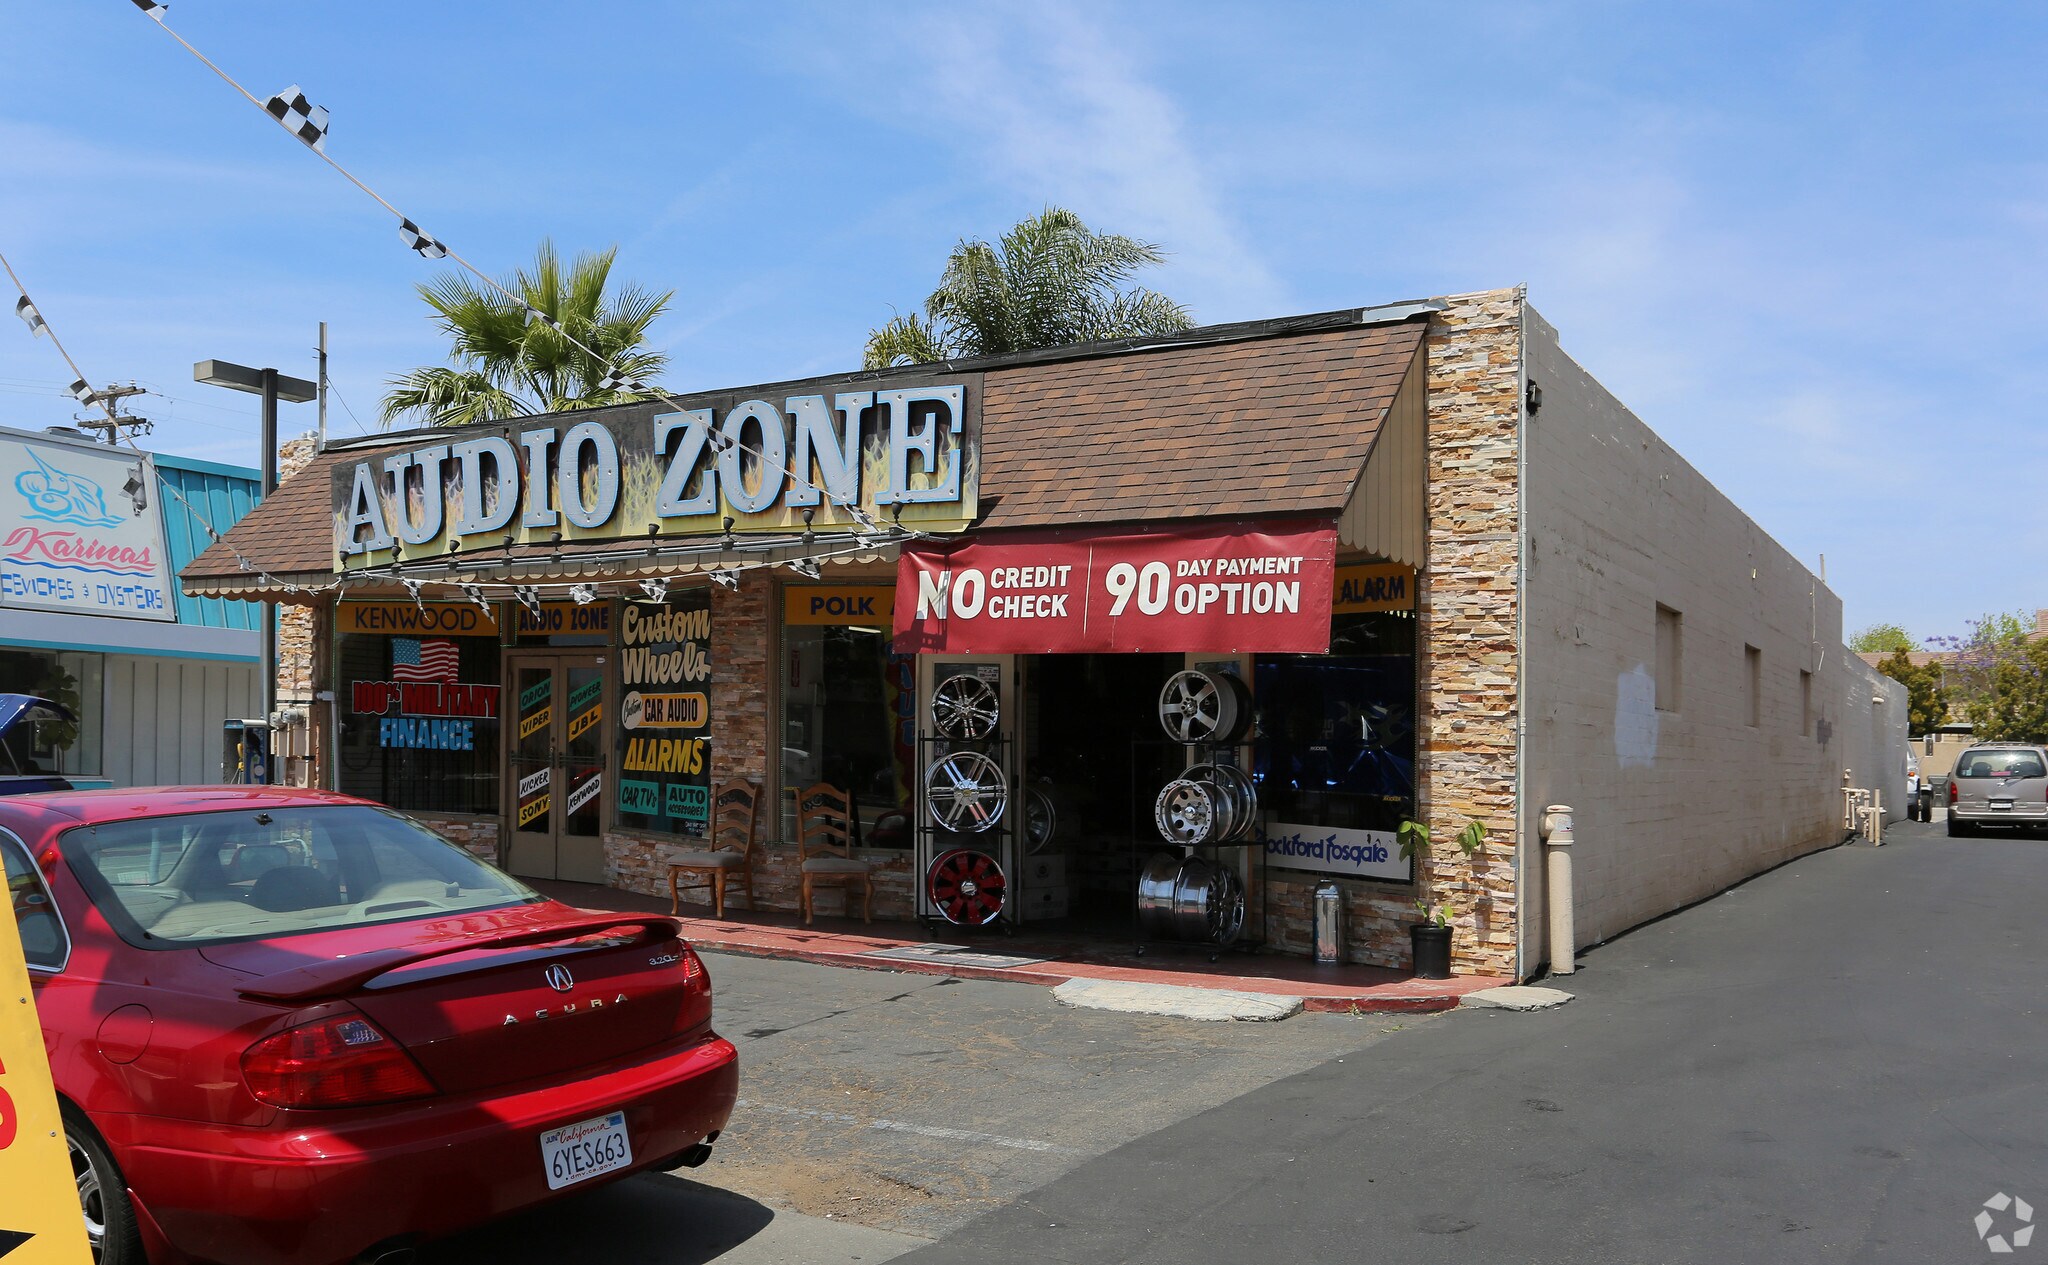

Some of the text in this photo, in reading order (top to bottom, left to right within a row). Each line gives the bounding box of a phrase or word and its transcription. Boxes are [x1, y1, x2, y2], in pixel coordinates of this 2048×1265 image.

[346, 383, 967, 556] AUDIO ZONE
[2, 527, 158, 572] Karinas
[990, 565, 1072, 589] CREDIT
[1176, 556, 1303, 577] DAY PAYMENT
[1, 573, 75, 600] CEVICHES
[96, 583, 164, 609] OYSTERS
[915, 568, 986, 620] NO
[1105, 560, 1171, 616] 90
[1174, 581, 1301, 615] OPTION
[1341, 575, 1406, 601] ALARM
[355, 606, 477, 631] KENWOOD
[519, 606, 608, 632] AUDIO ZONE
[810, 596, 875, 616] POLK
[988, 594, 1069, 619] CHECK
[622, 603, 712, 646] Custom
[621, 641, 712, 685] Wheels
[352, 680, 501, 719] 100% MILITARY
[521, 683, 550, 707] ORION
[569, 681, 602, 707] PIONEER
[522, 710, 549, 734] VIPER
[571, 711, 598, 735] JBL
[644, 698, 663, 722] CAR
[667, 698, 698, 722] AUDIO
[380, 718, 474, 751] FINANCE
[623, 738, 704, 775] ALARMS
[520, 771, 549, 795] KICKER
[568, 779, 600, 810] KENWOOD
[668, 787, 706, 805] AUTO
[521, 796, 549, 821] SONY
[622, 786, 639, 808] CAR
[667, 803, 705, 817] ACCESSORIES
[503, 993, 628, 1026] ACURA
[560, 1123, 612, 1144] California
[553, 1133, 625, 1178] 6YES663
[570, 1162, 612, 1180] dmv.ca.gov
